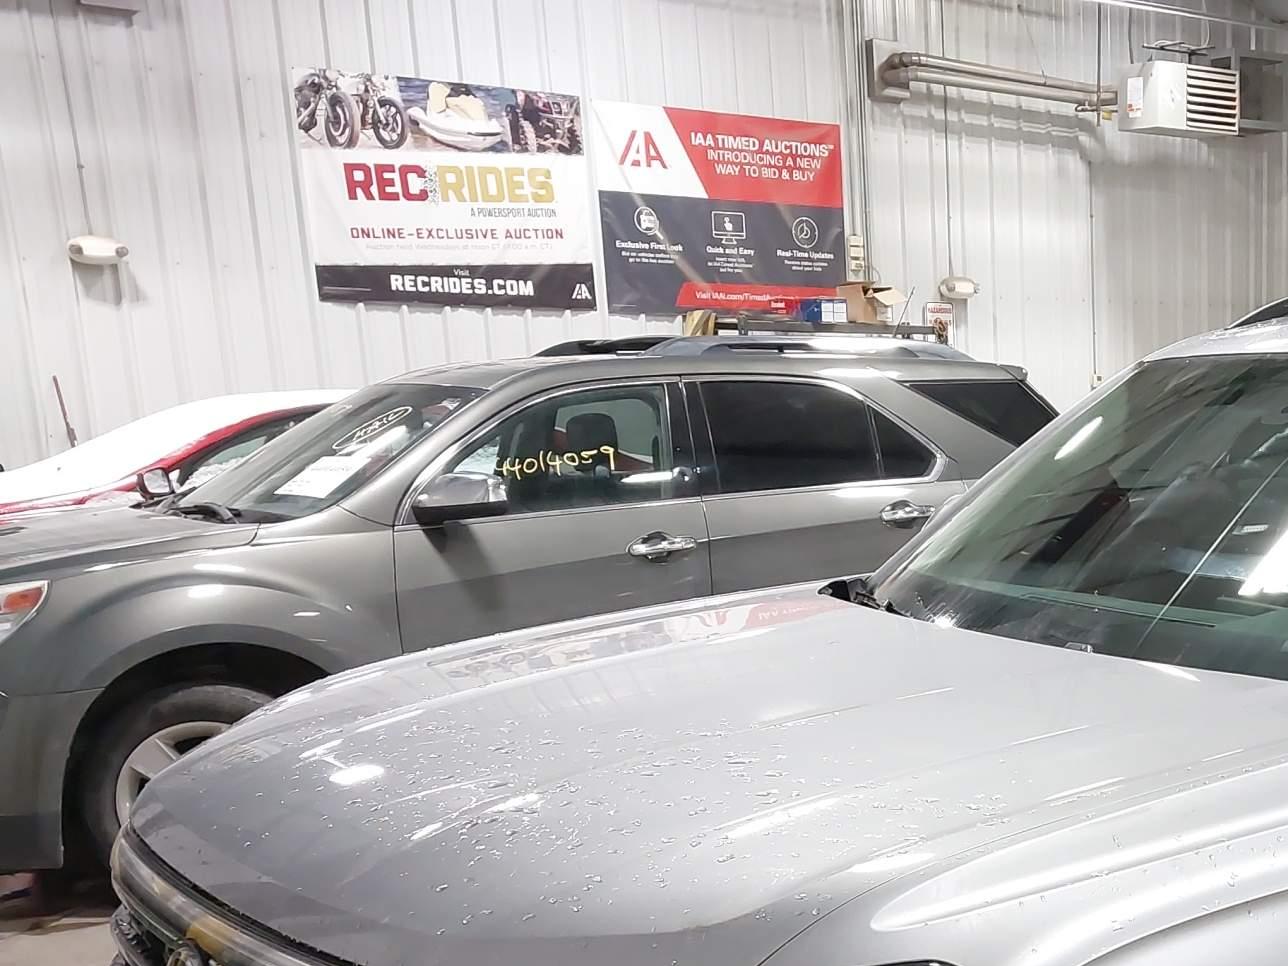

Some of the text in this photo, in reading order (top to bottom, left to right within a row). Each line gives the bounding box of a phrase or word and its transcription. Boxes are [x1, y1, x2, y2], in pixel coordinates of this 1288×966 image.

[690, 132, 714, 147] IAA
[716, 135, 759, 150] TIMED
[707, 149, 821, 169] INTRODUCING A NEW
[714, 163, 815, 181] WAY TO BID & BUY
[470, 207, 557, 218] A POWERSPORT AUCTION
[350, 227, 564, 240] ONLINE-EXCLUSIVE AUCTION
[390, 274, 535, 296] RECRIDES.COM
